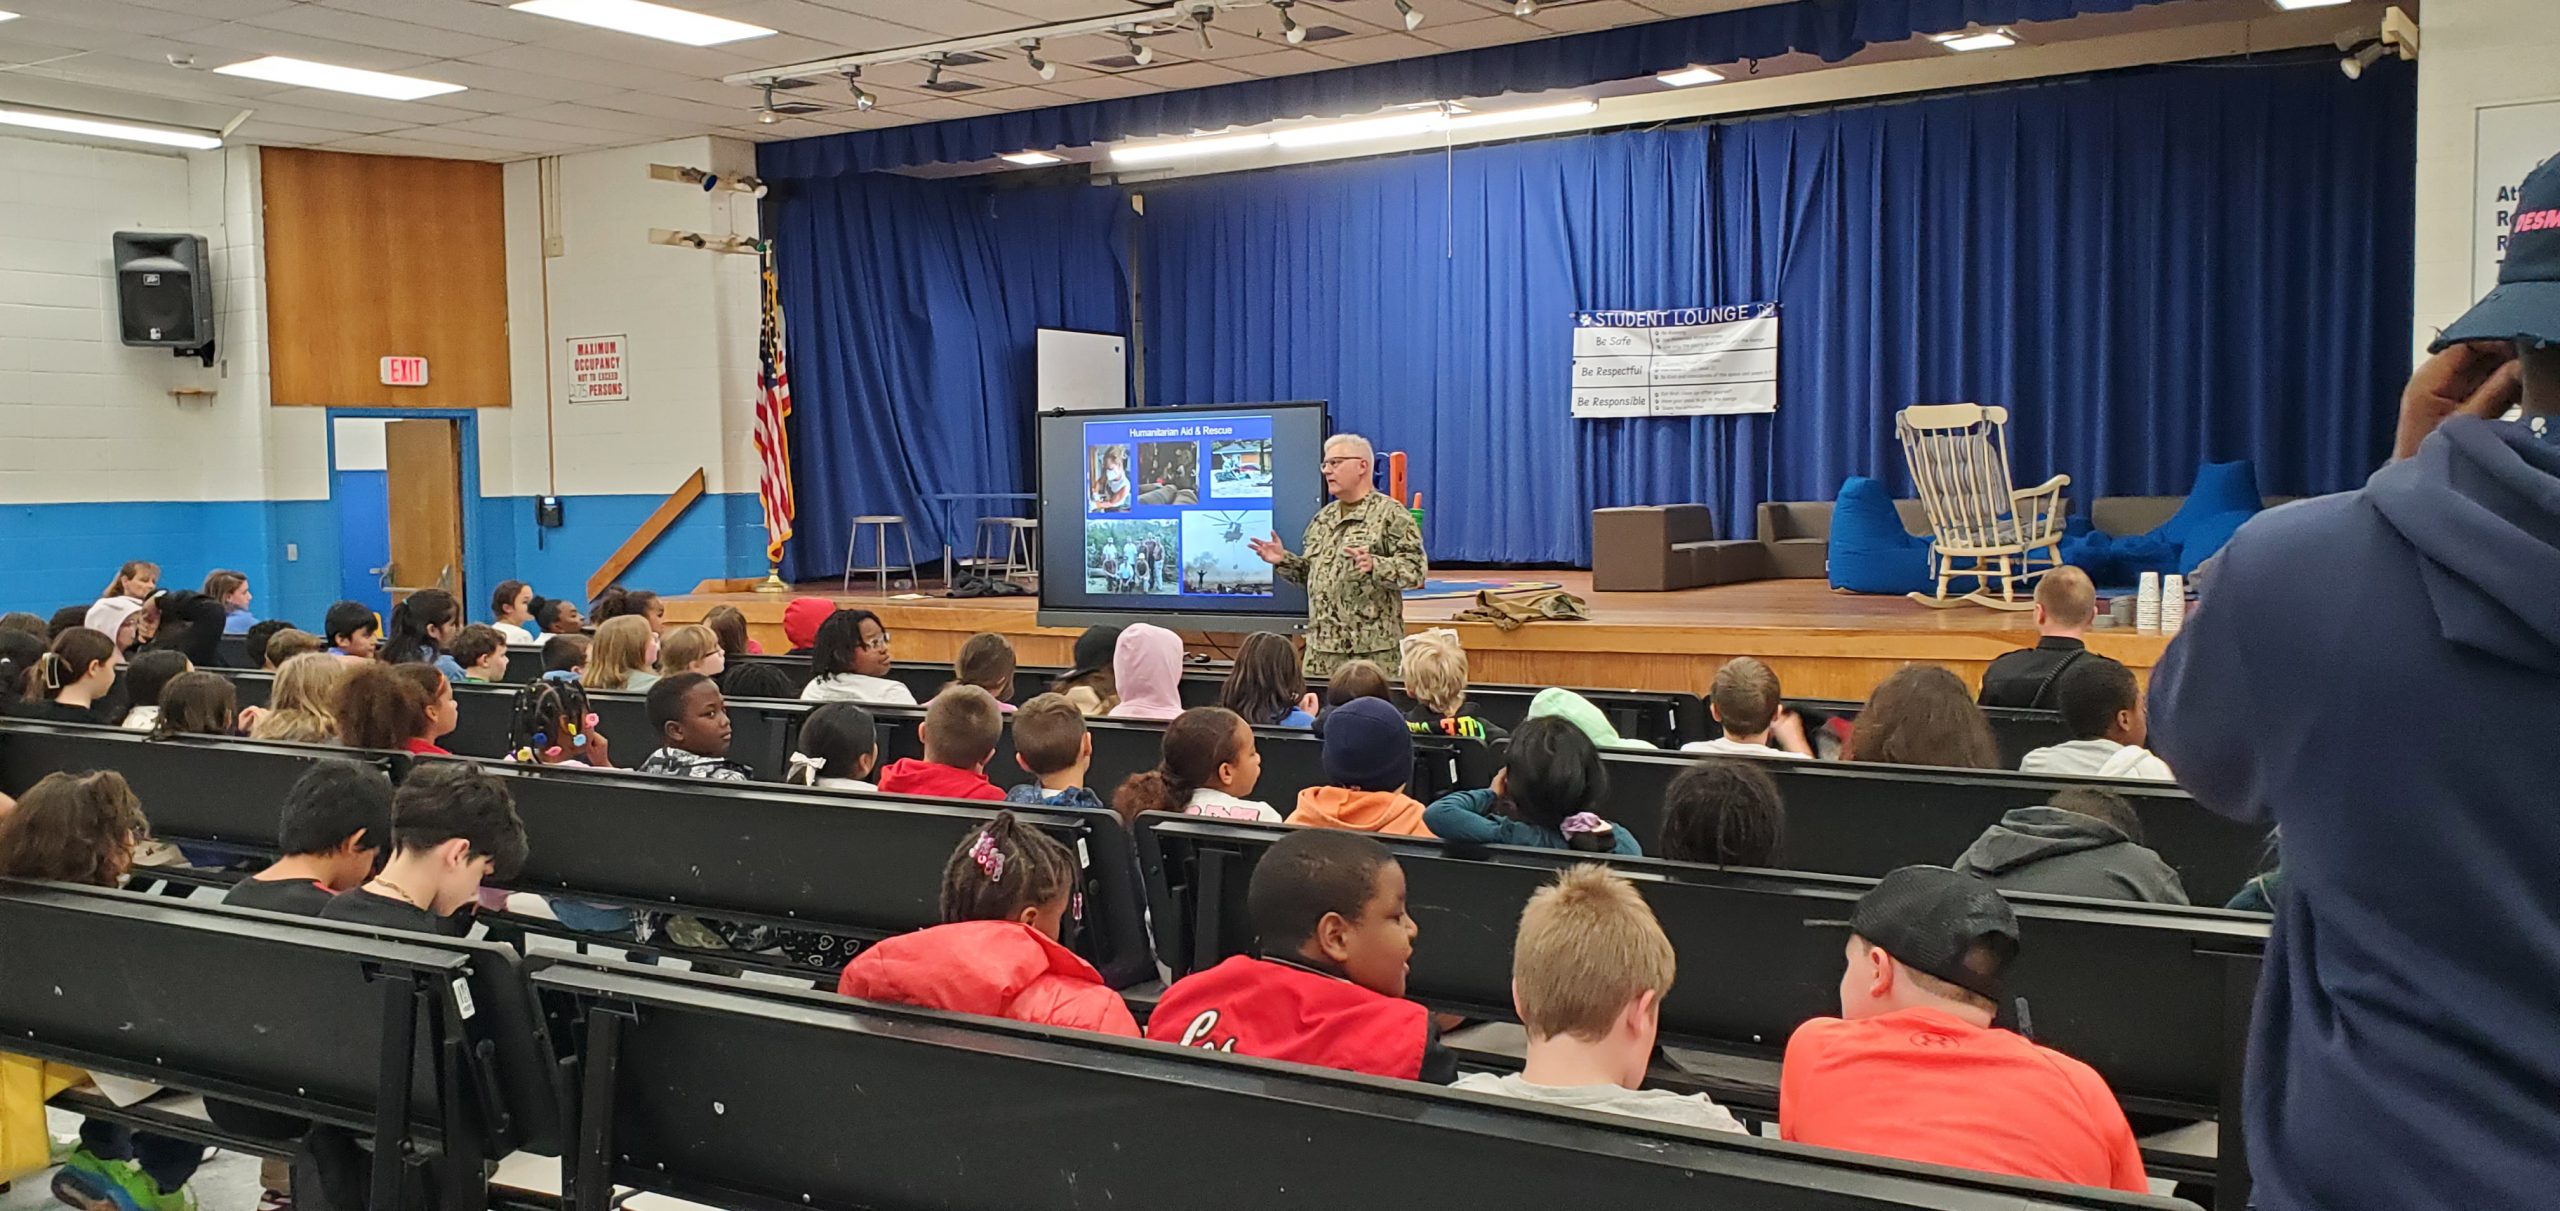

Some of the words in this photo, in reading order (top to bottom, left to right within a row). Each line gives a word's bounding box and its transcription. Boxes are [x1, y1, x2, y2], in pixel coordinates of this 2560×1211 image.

[1595, 312, 1668, 328] STUDENT
[1674, 304, 1750, 321] LOUNGE
[1596, 336, 1607, 346] Be
[1609, 335, 1632, 346] Safe
[577, 341, 616, 356] MAXIMUM
[390, 358, 421, 383] EXIT
[575, 356, 620, 371] OCCUPANCY
[577, 373, 588, 382] NOT
[589, 373, 596, 381] TO
[598, 371, 618, 381] EXCEED
[1581, 367, 1594, 377] Be
[1596, 365, 1643, 378] Respectful
[589, 382, 623, 397] PERSONS
[1577, 397, 1590, 407] Be
[1592, 395, 1646, 409] Responsible
[1129, 428, 1179, 438] Humanitarian
[1180, 426, 1193, 436] Aid
[1194, 426, 1201, 436] &
[1202, 425, 1233, 435] Rescue
